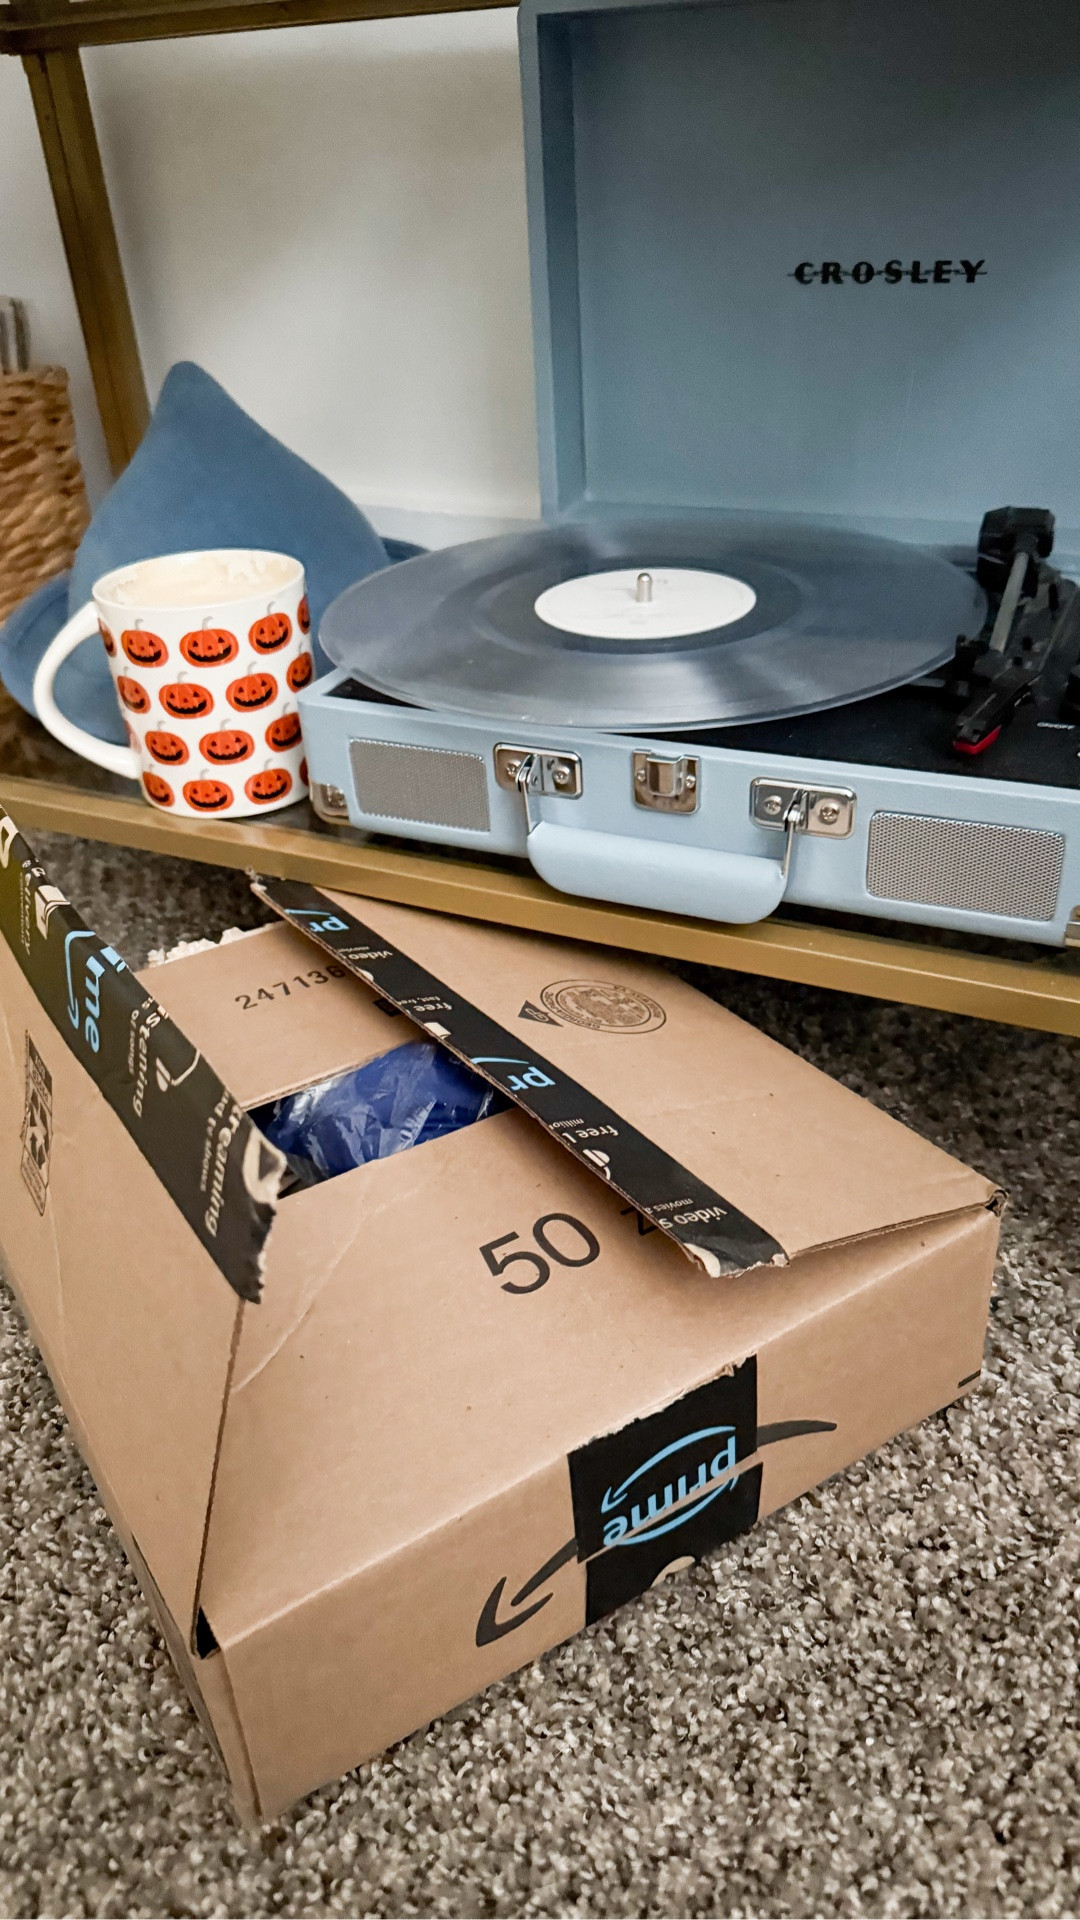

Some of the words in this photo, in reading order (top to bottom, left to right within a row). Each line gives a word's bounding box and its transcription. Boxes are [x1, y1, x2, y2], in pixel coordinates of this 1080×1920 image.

[795, 259, 986, 285] CROSLEY
[235, 965, 346, 1010] 247136
[413, 1002, 453, 1012] free
[575, 1125, 619, 1139] free
[653, 1198, 695, 1212] movies
[673, 1206, 728, 1226] video
[479, 1212, 601, 1295] 50
[603, 1436, 736, 1546] prime
